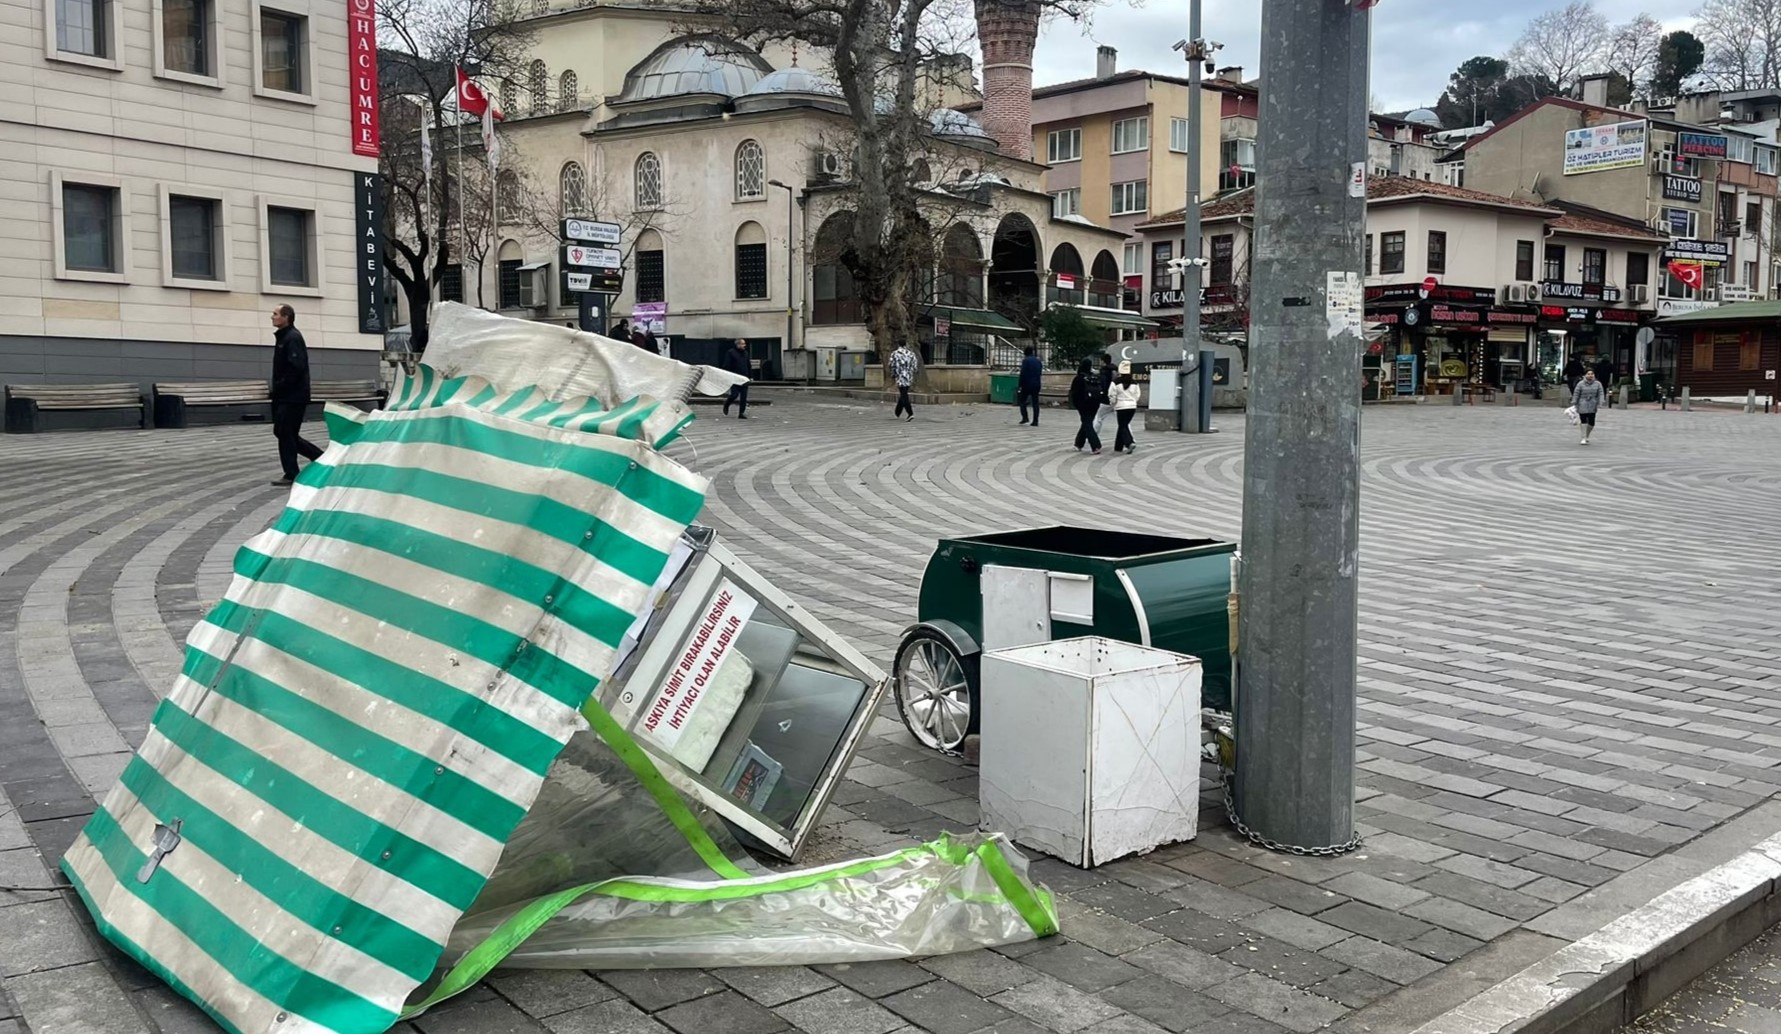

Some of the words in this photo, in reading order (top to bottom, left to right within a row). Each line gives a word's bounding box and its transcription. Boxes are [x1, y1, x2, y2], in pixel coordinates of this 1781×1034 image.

[1682, 134, 1725, 147] TATTOO
[1682, 144, 1725, 155] PIERCING
[1666, 176, 1700, 193] TATTOO
[364, 176, 376, 304] KİTABEVİ
[1162, 289, 1205, 304] KILAZ
[1550, 285, 1583, 298] KILAVUZ
[645, 697, 671, 733] ASKIYA
[664, 669, 686, 698] SİMİT
[680, 590, 733, 672] BIRAKABİLİRSİNİZ
[667, 686, 700, 730] İHTİYACI
[694, 658, 716, 687] OLAN
[710, 615, 742, 662] ALABİLİR
